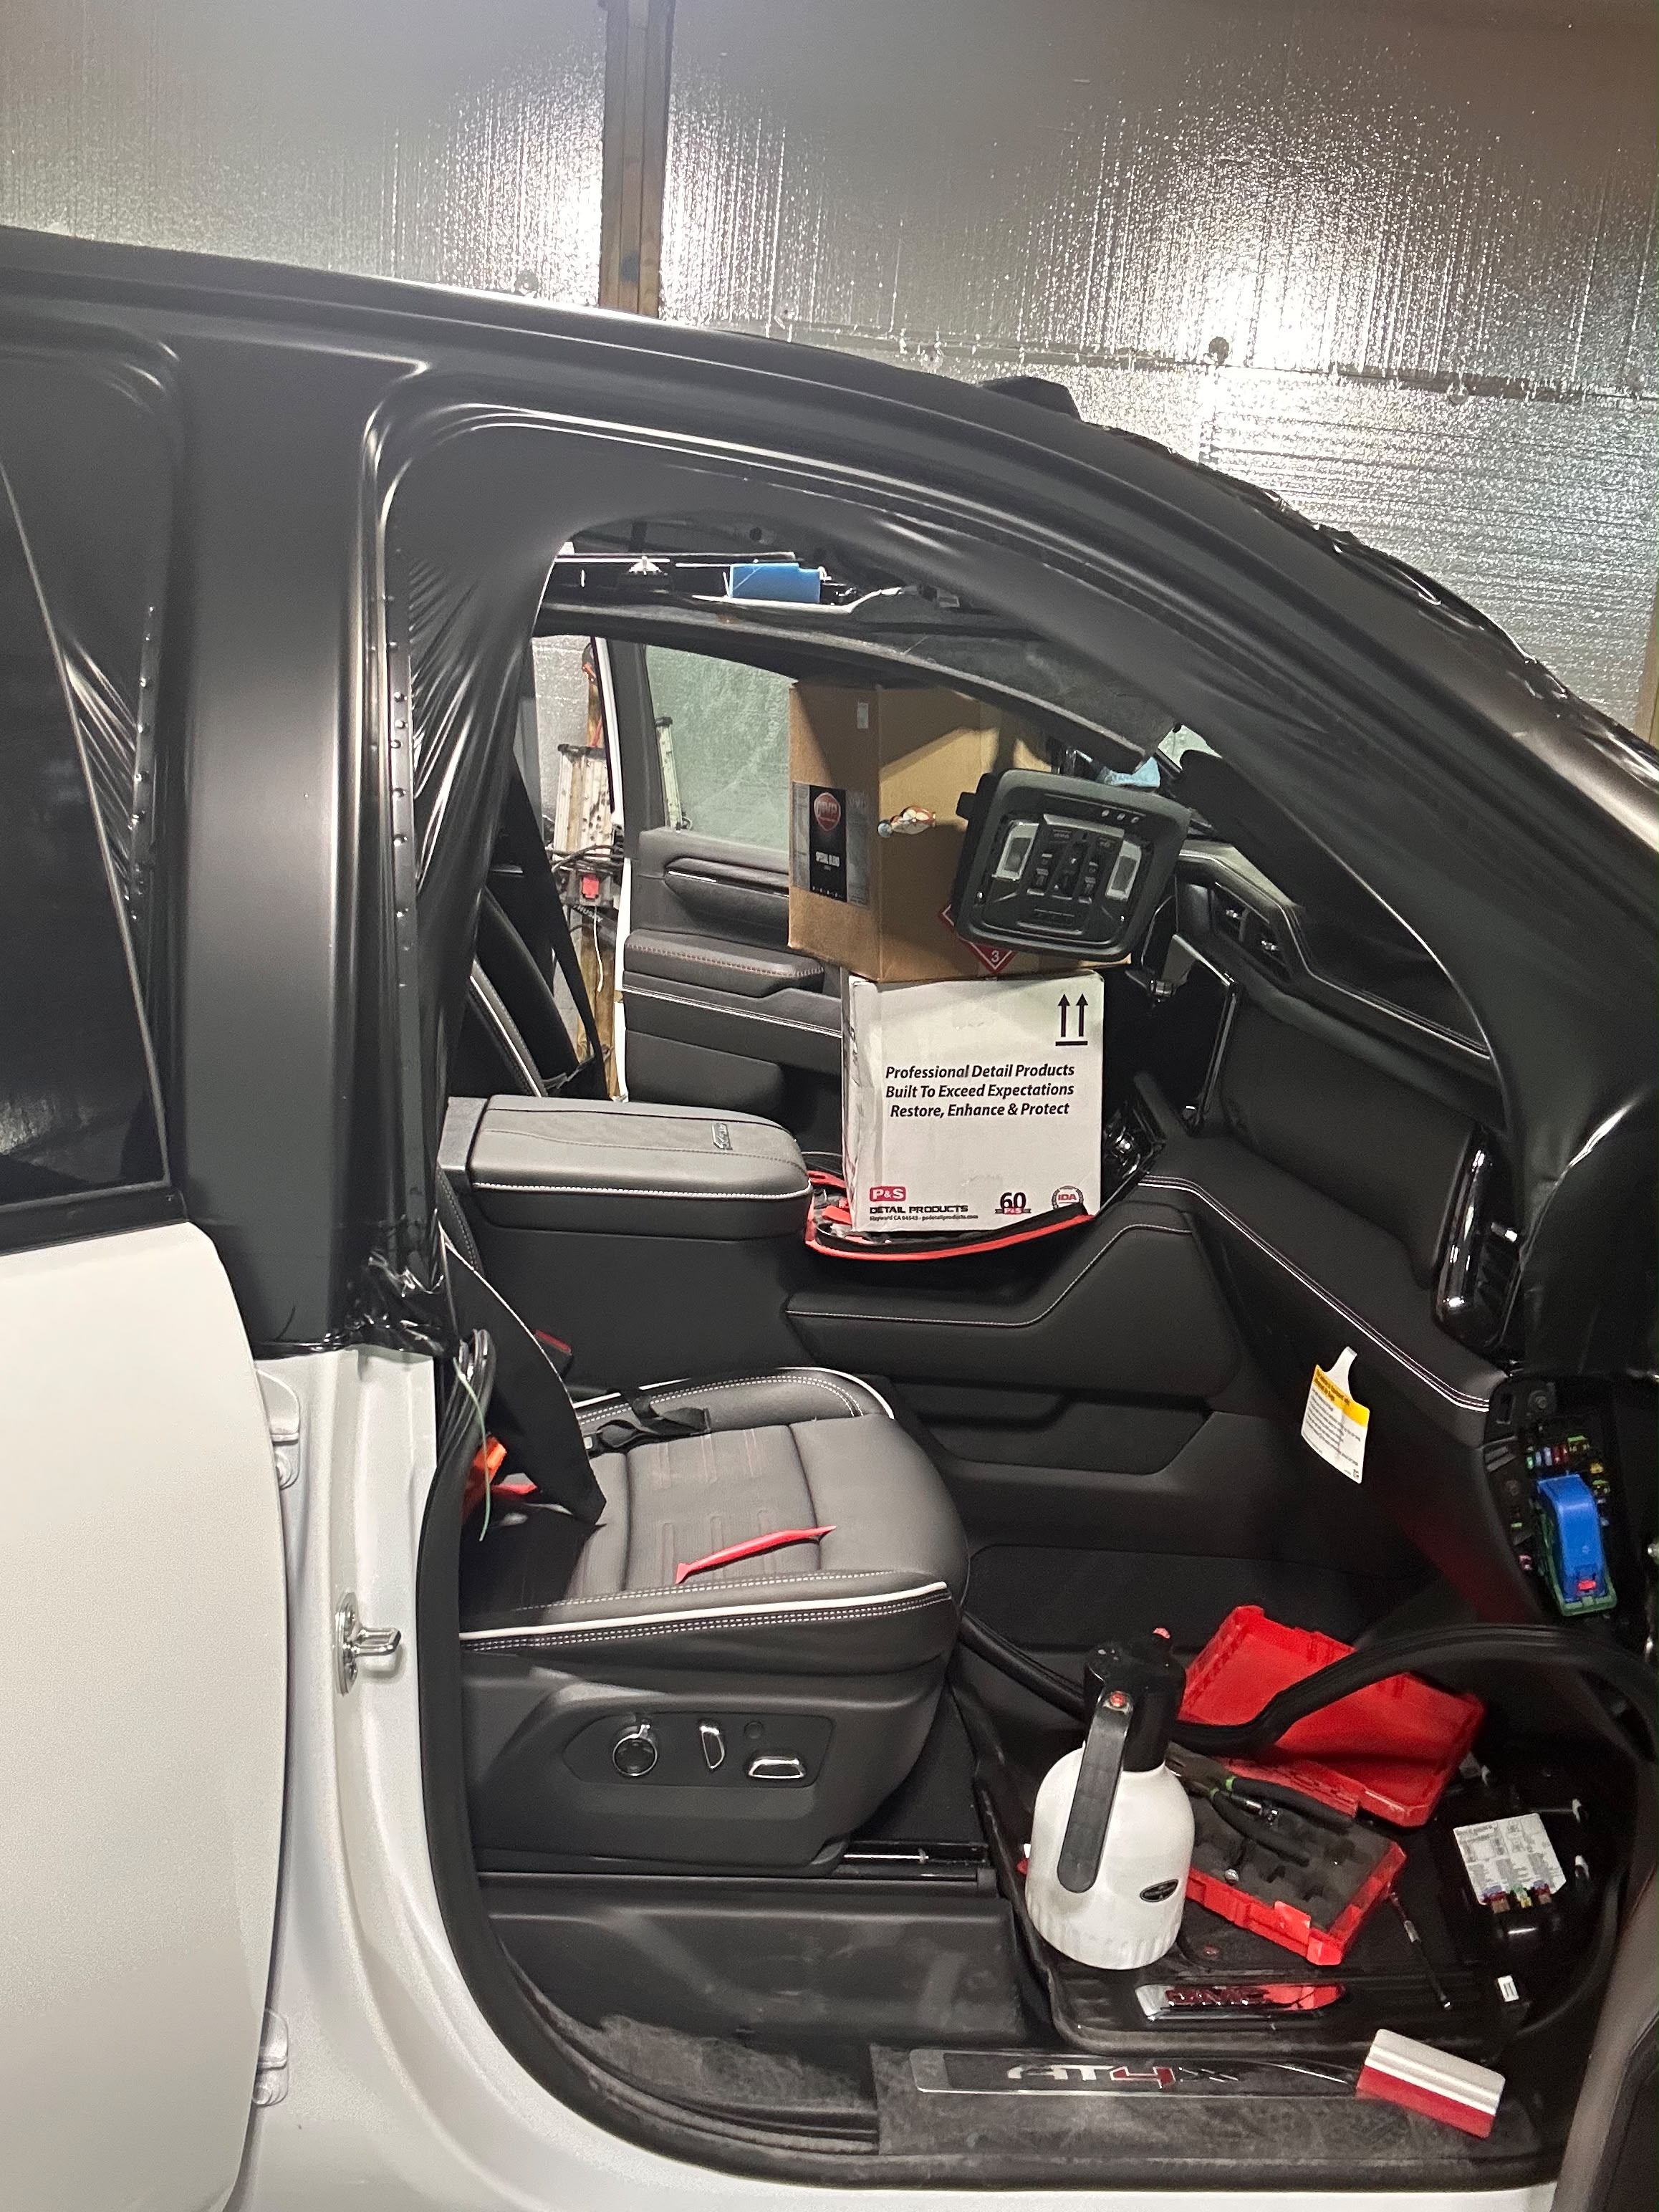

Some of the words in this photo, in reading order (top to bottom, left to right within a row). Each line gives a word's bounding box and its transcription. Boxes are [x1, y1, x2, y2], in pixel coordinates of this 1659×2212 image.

[991, 950, 1000, 963] 3
[885, 1065, 969, 1079] Professional
[972, 1064, 1014, 1077] Detail
[1016, 1064, 1075, 1077] Products
[885, 1085, 918, 1098] Built
[920, 1085, 936, 1097] To
[938, 1084, 986, 1097] Exceed
[988, 1083, 1074, 1100] Expectations
[890, 1105, 944, 1118] Restore,
[948, 1103, 1005, 1117] Enhance
[1007, 1103, 1018, 1115] &
[1021, 1102, 1070, 1115] Protect
[872, 1188, 905, 1200] P&S
[999, 1192, 1026, 1208] 60
[908, 1205, 968, 1213] PRODUCTS
